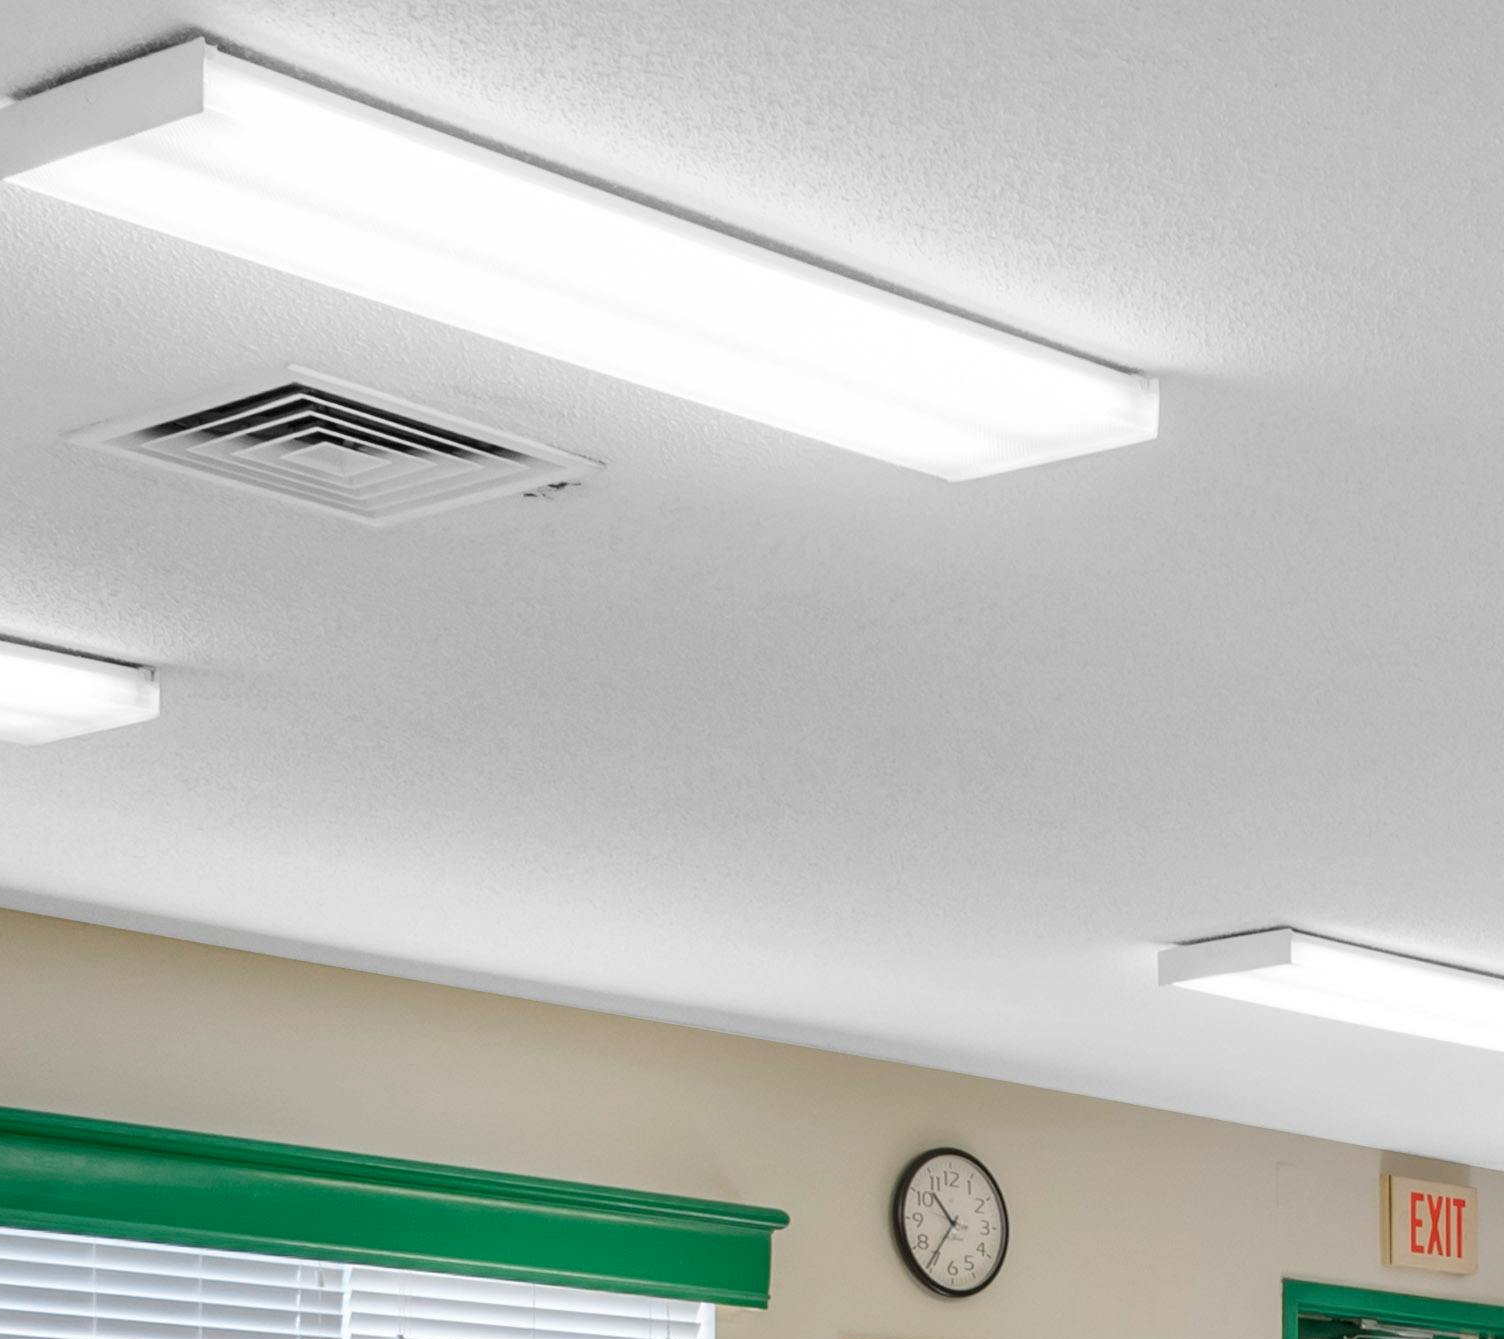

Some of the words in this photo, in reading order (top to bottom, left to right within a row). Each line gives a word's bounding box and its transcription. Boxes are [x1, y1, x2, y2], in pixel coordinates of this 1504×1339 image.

[930, 1176, 940, 1191] 11
[944, 1171, 959, 1188] 12
[967, 1180, 971, 1195] 1
[917, 1191, 934, 1207] 10
[975, 1198, 984, 1214] 2
[912, 1212, 924, 1228] 9
[980, 1220, 990, 1235] 3
[1411, 1192, 1466, 1258] EXIT
[917, 1234, 928, 1249] 8
[976, 1242, 986, 1256] 4
[947, 1260, 958, 1276] 6
[964, 1255, 974, 1271] 5
